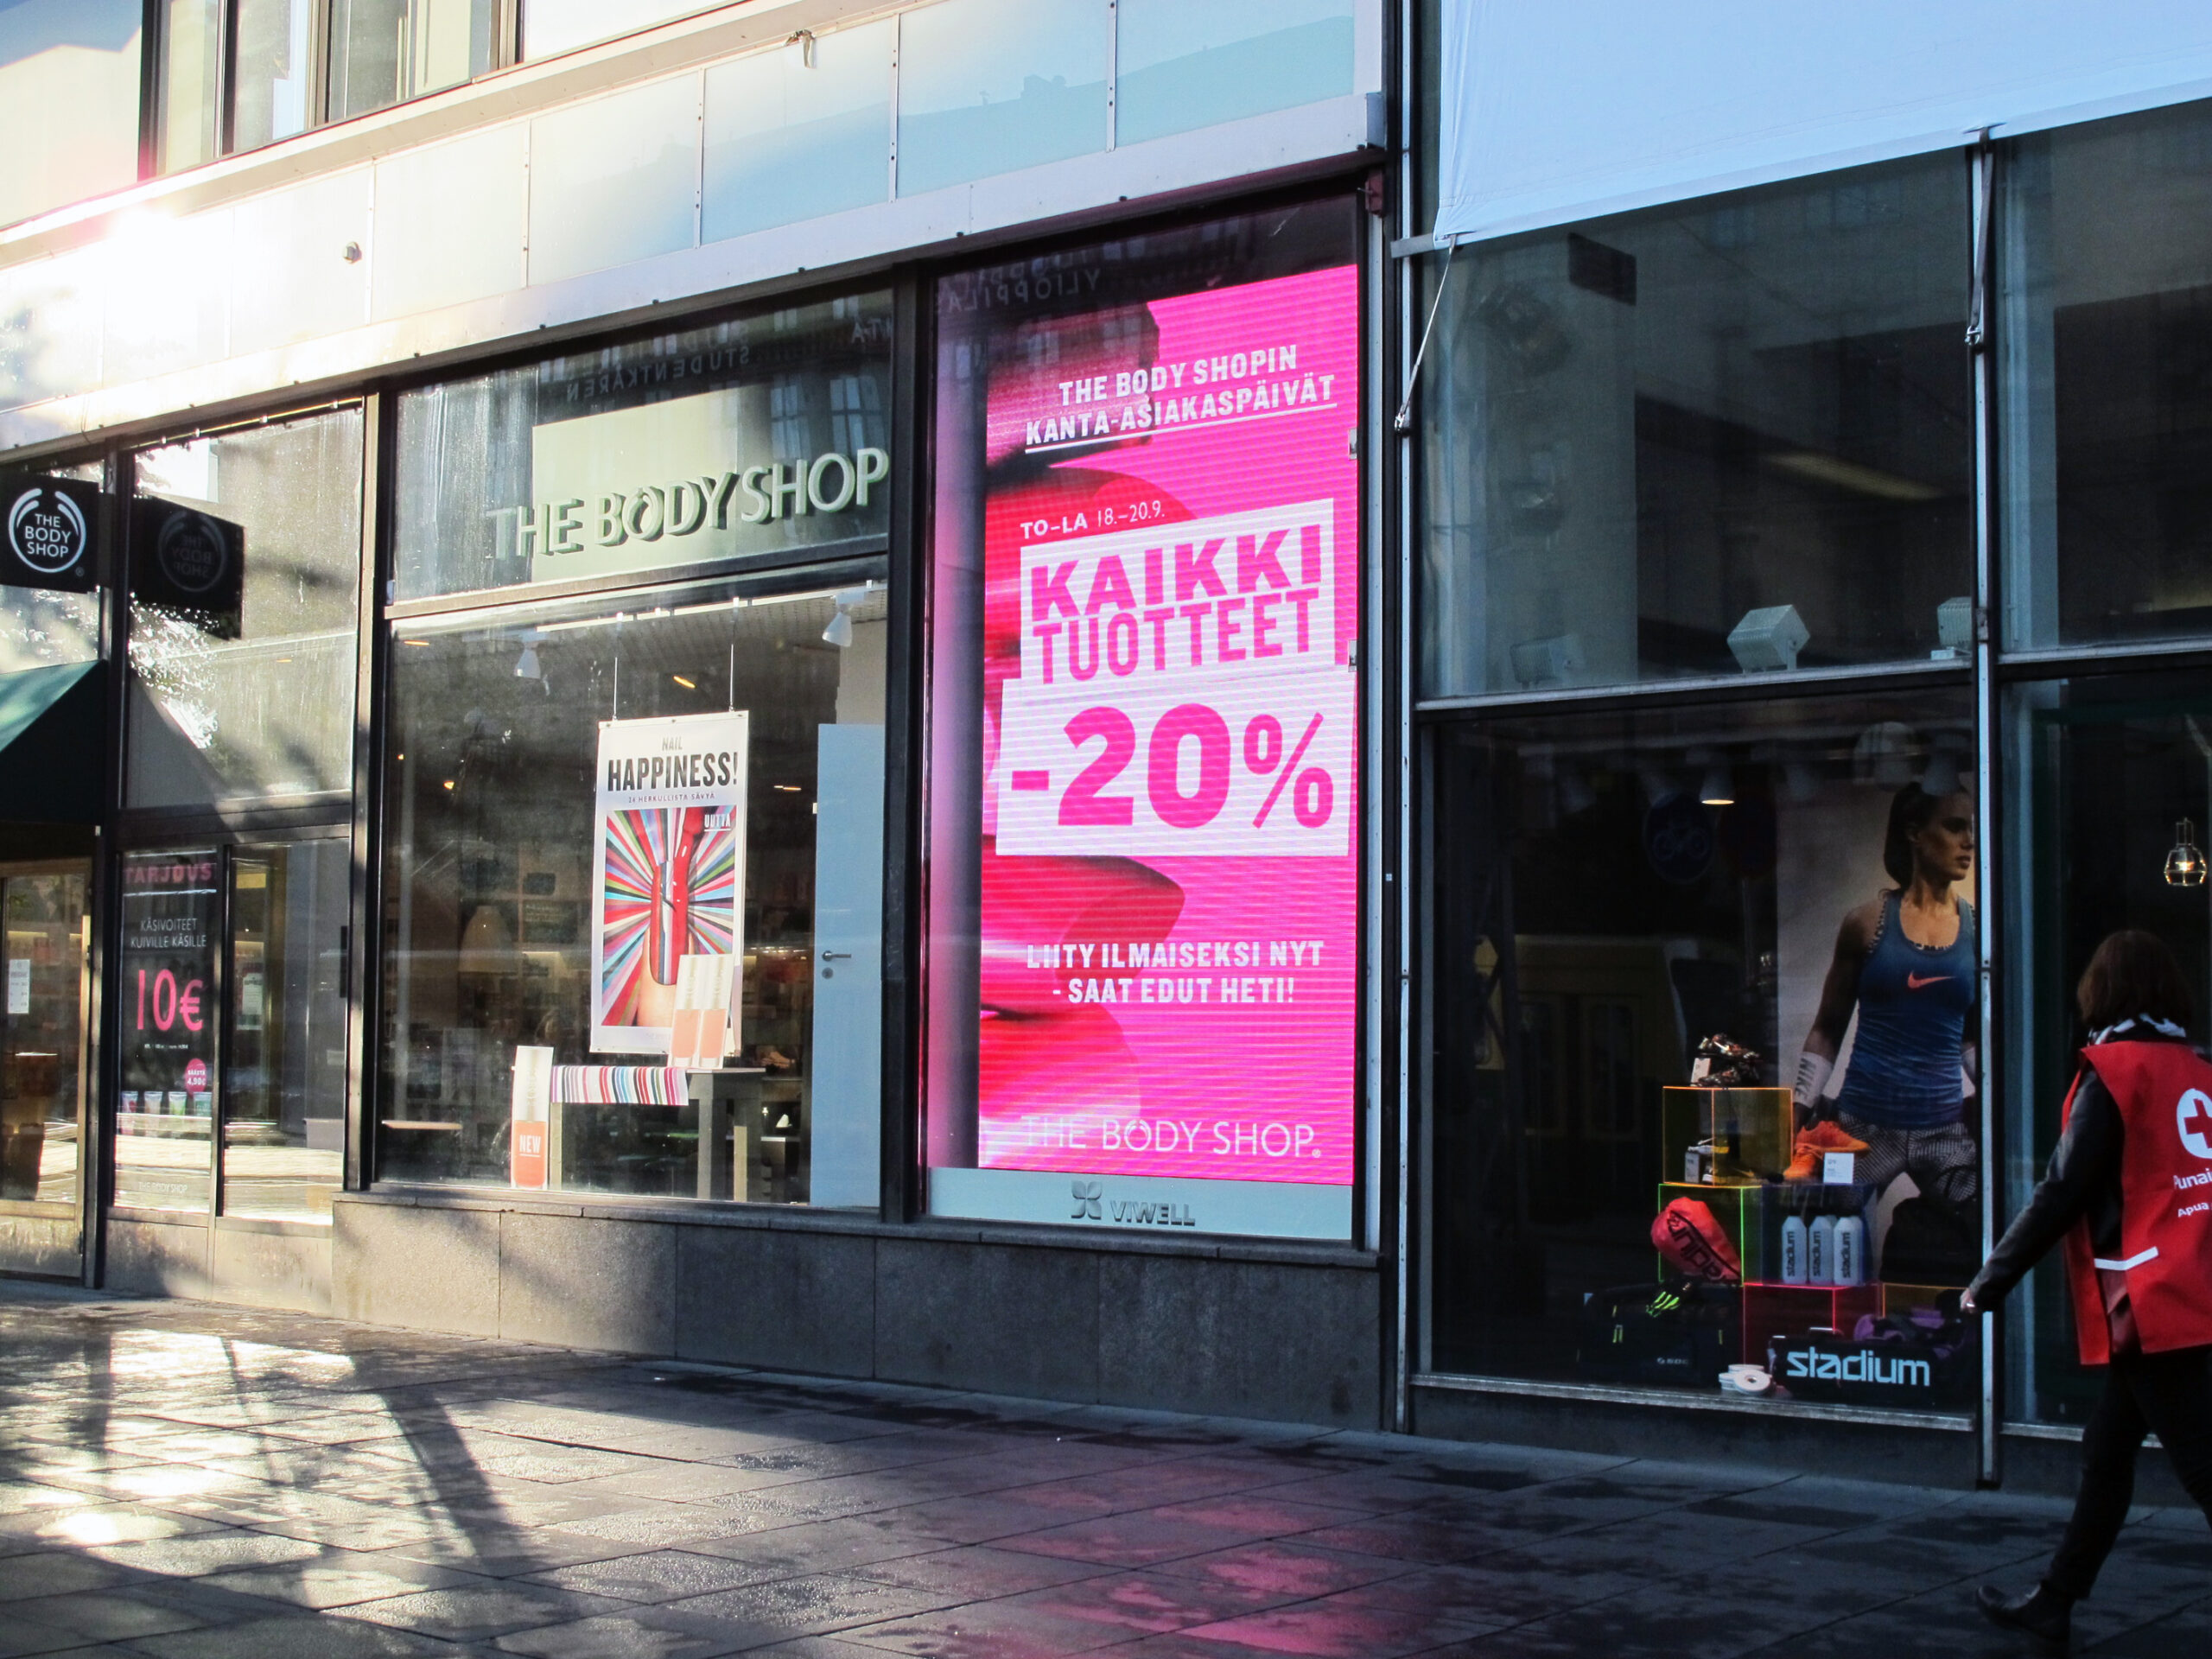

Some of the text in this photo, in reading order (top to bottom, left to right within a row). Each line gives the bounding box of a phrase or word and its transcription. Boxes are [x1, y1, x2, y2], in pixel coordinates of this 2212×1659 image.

[1058, 344, 1297, 406] THE BODY SHOPIN
[1026, 372, 1335, 445] KANTA-ASIAKASPÄIVÄT
[35, 513, 61, 528] THE
[486, 447, 890, 561] THE BODY SHOP
[24, 525, 71, 543] BODY
[27, 542, 69, 558] SHOP
[1031, 524, 1322, 622] KAIKKI
[1033, 587, 1319, 684] TUOTTEET
[662, 736, 683, 751] NAIL
[607, 752, 738, 791] HAPPINESS!
[1011, 702, 1334, 830] -20%
[639, 793, 689, 803] HERKULLISTA
[704, 813, 731, 828] UUTTA
[124, 862, 213, 884] TARJOUS
[130, 933, 207, 949] KUIVILLE KÄSILLE
[140, 918, 198, 932] KÄSIVOITEET
[1027, 940, 1324, 968] LIITY ILMAISEKSI NYT
[137, 969, 204, 1031] 10€
[1069, 977, 1133, 1003] SAAT
[1141, 977, 1212, 1003] EDUT
[1220, 977, 1294, 1003] HETI!
[1795, 1058, 1816, 1100] NIKE
[519, 1135, 541, 1153] NEW
[1021, 1116, 1087, 1149] THE
[1102, 1118, 1202, 1154] BODY
[1109, 1199, 1196, 1226] VIWELL
[2177, 1202, 2209, 1217] Apua
[1786, 1230, 1796, 1277] stadium
[1813, 1230, 1821, 1277] stadium
[1840, 1232, 1851, 1279] stadium
[1786, 1346, 1930, 1387] stadium
